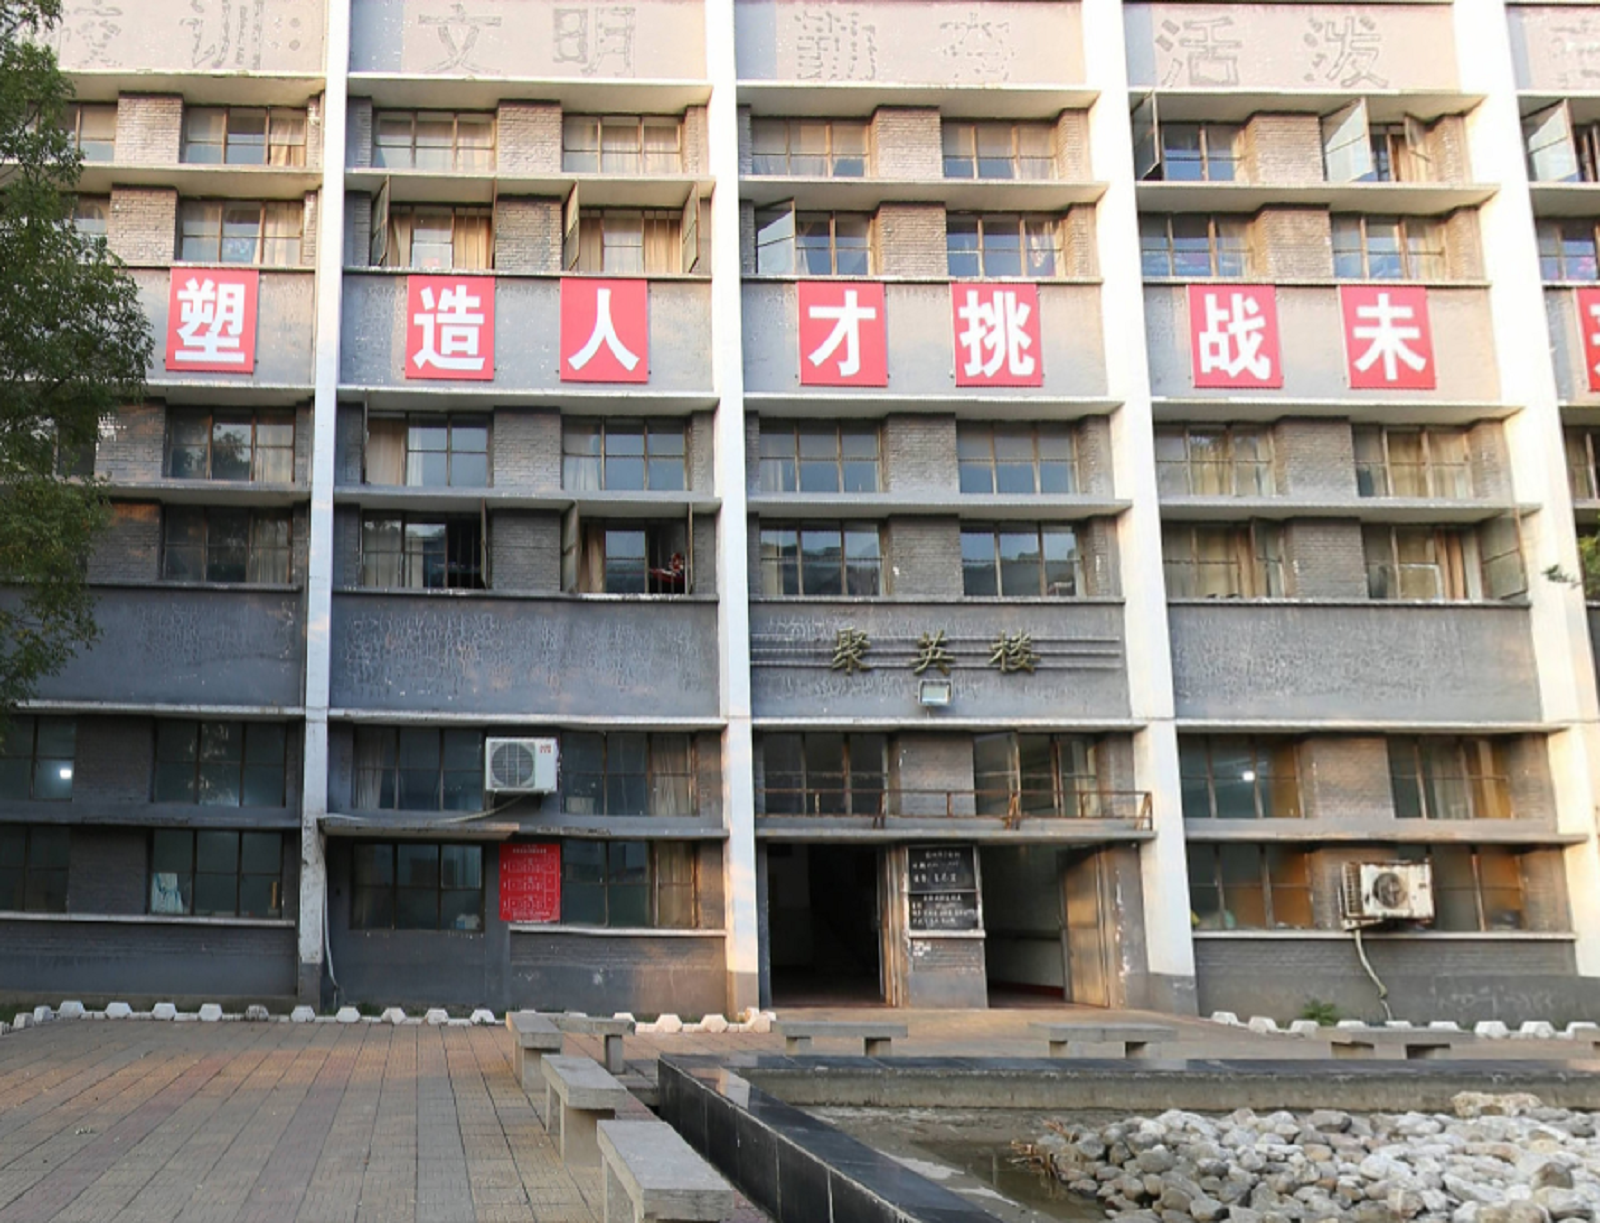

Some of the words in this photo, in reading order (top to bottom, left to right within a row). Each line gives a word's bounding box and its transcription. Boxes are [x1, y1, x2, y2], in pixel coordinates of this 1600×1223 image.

[417, 3, 636, 77] 文明
[1155, 16, 1390, 88] 活泼
[832, 626, 1041, 675] 聚英楼
